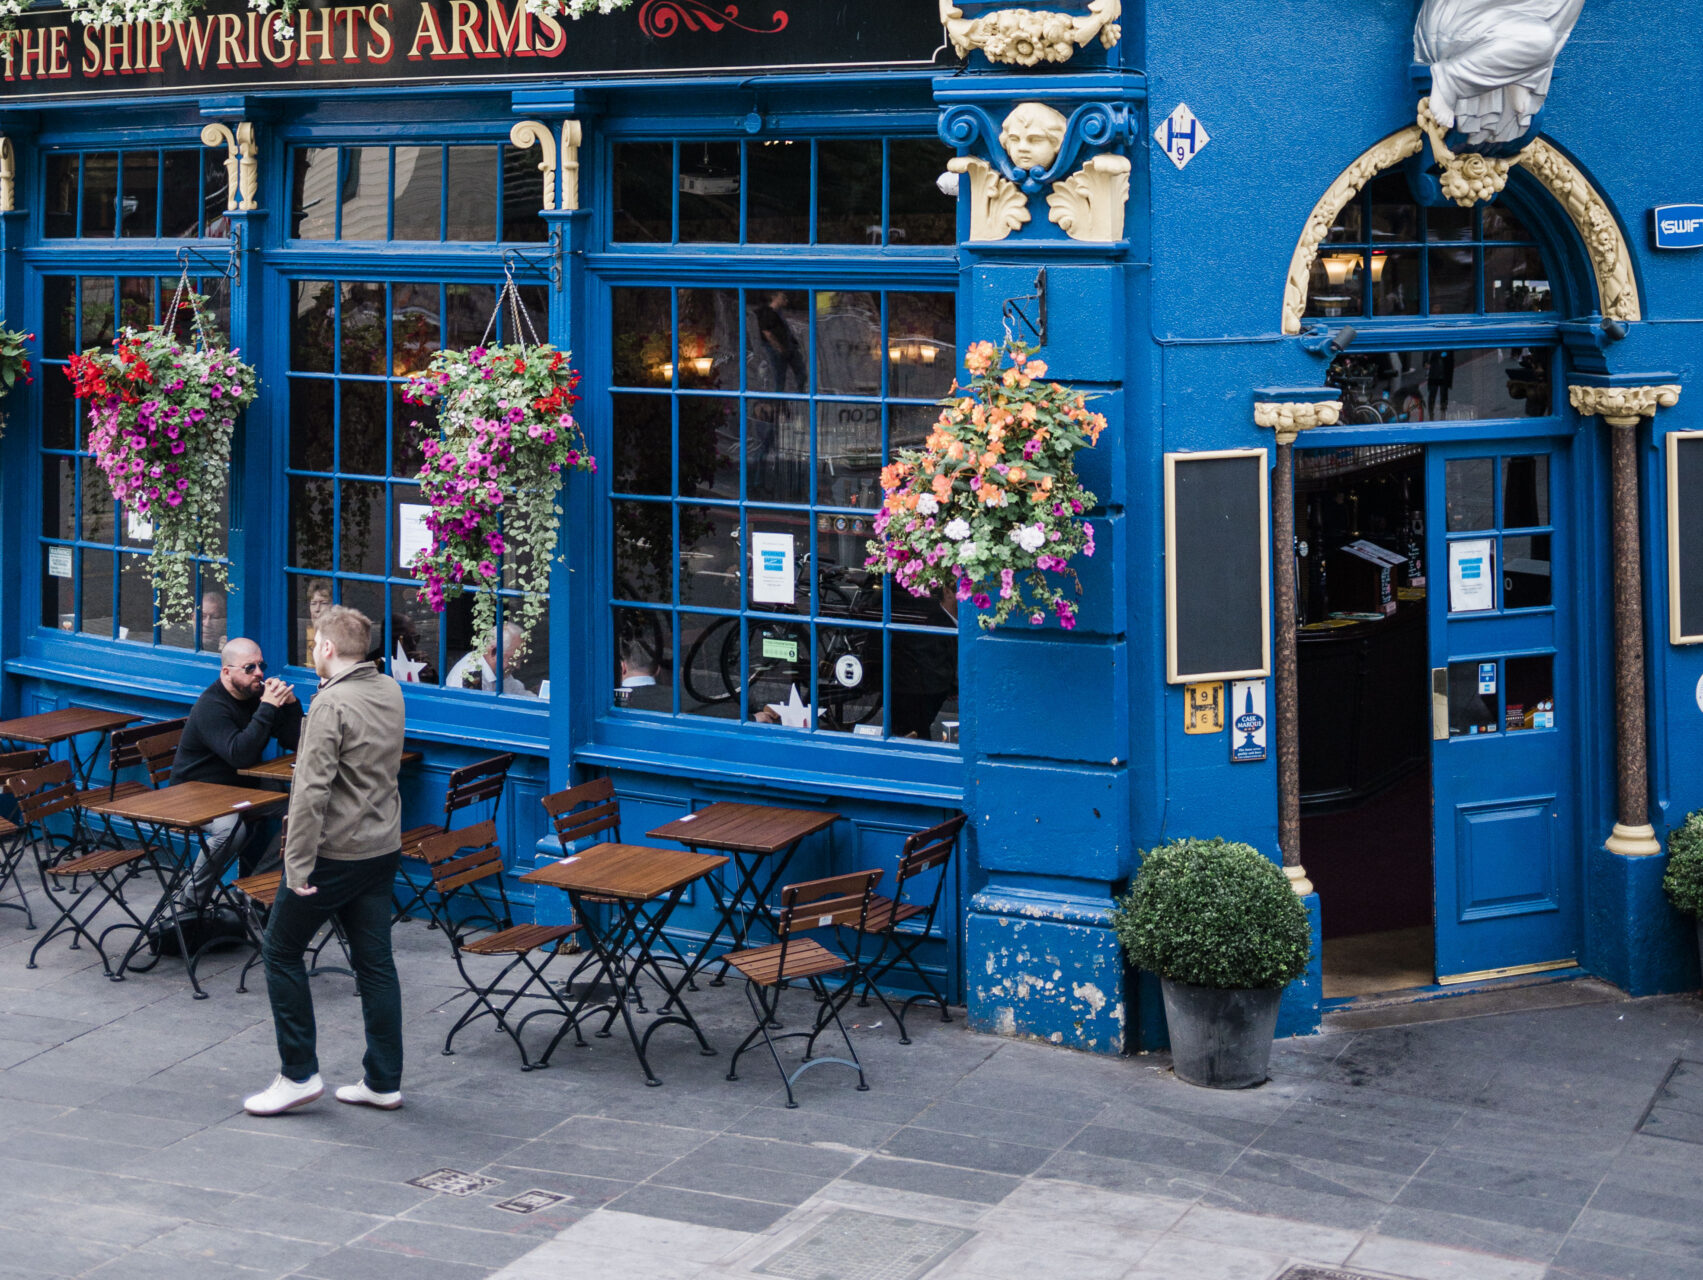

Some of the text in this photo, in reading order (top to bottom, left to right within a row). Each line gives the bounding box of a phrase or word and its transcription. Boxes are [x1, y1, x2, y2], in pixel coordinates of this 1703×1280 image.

[1, 26, 71, 81] THE
[82, 3, 394, 78] SHIPWRIGHTS
[1167, 117, 1196, 153] H
[1177, 146, 1185, 161] 9
[1660, 219, 1703, 234] SWIF
[1191, 687, 1219, 728] H
[1201, 691, 1208, 701] 9
